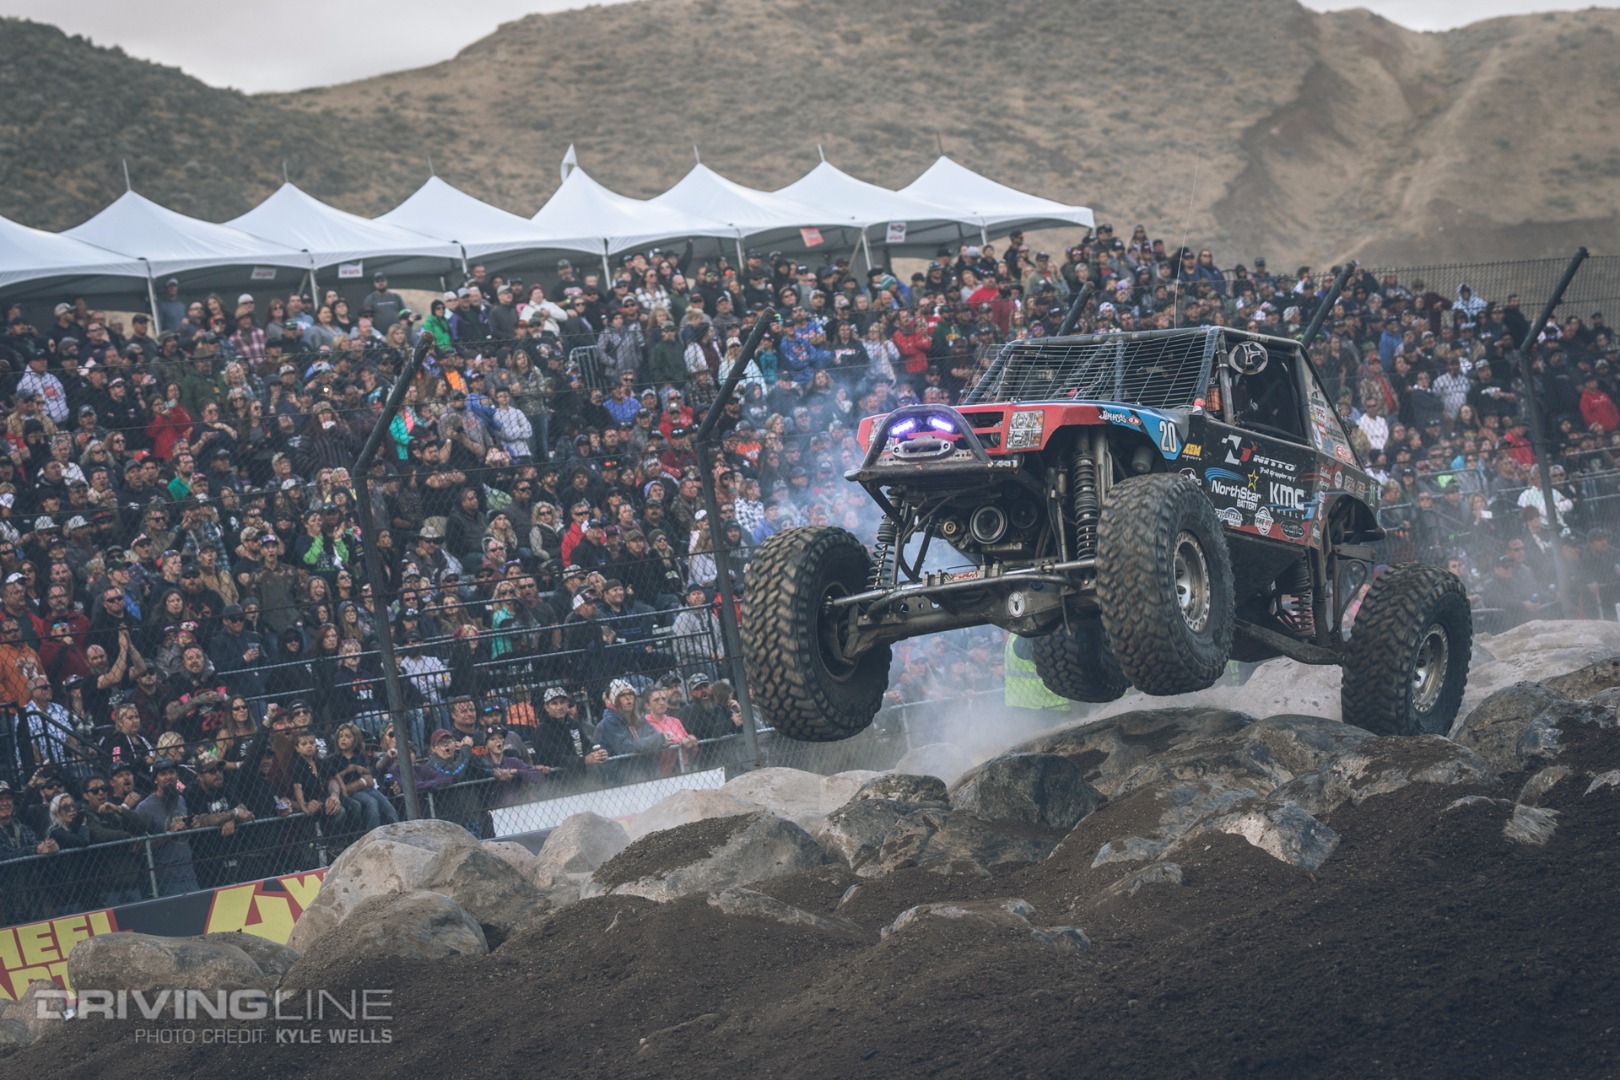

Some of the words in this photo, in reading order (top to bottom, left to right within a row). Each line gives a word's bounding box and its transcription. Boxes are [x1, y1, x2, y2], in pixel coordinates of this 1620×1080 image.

[1159, 420, 1177, 453] 20
[1182, 443, 1202, 457] AEM
[1253, 454, 1297, 472] NITTO
[1211, 480, 1262, 503] NorthStar
[1269, 481, 1305, 511] KMC
[1236, 499, 1258, 512] BATTERY
